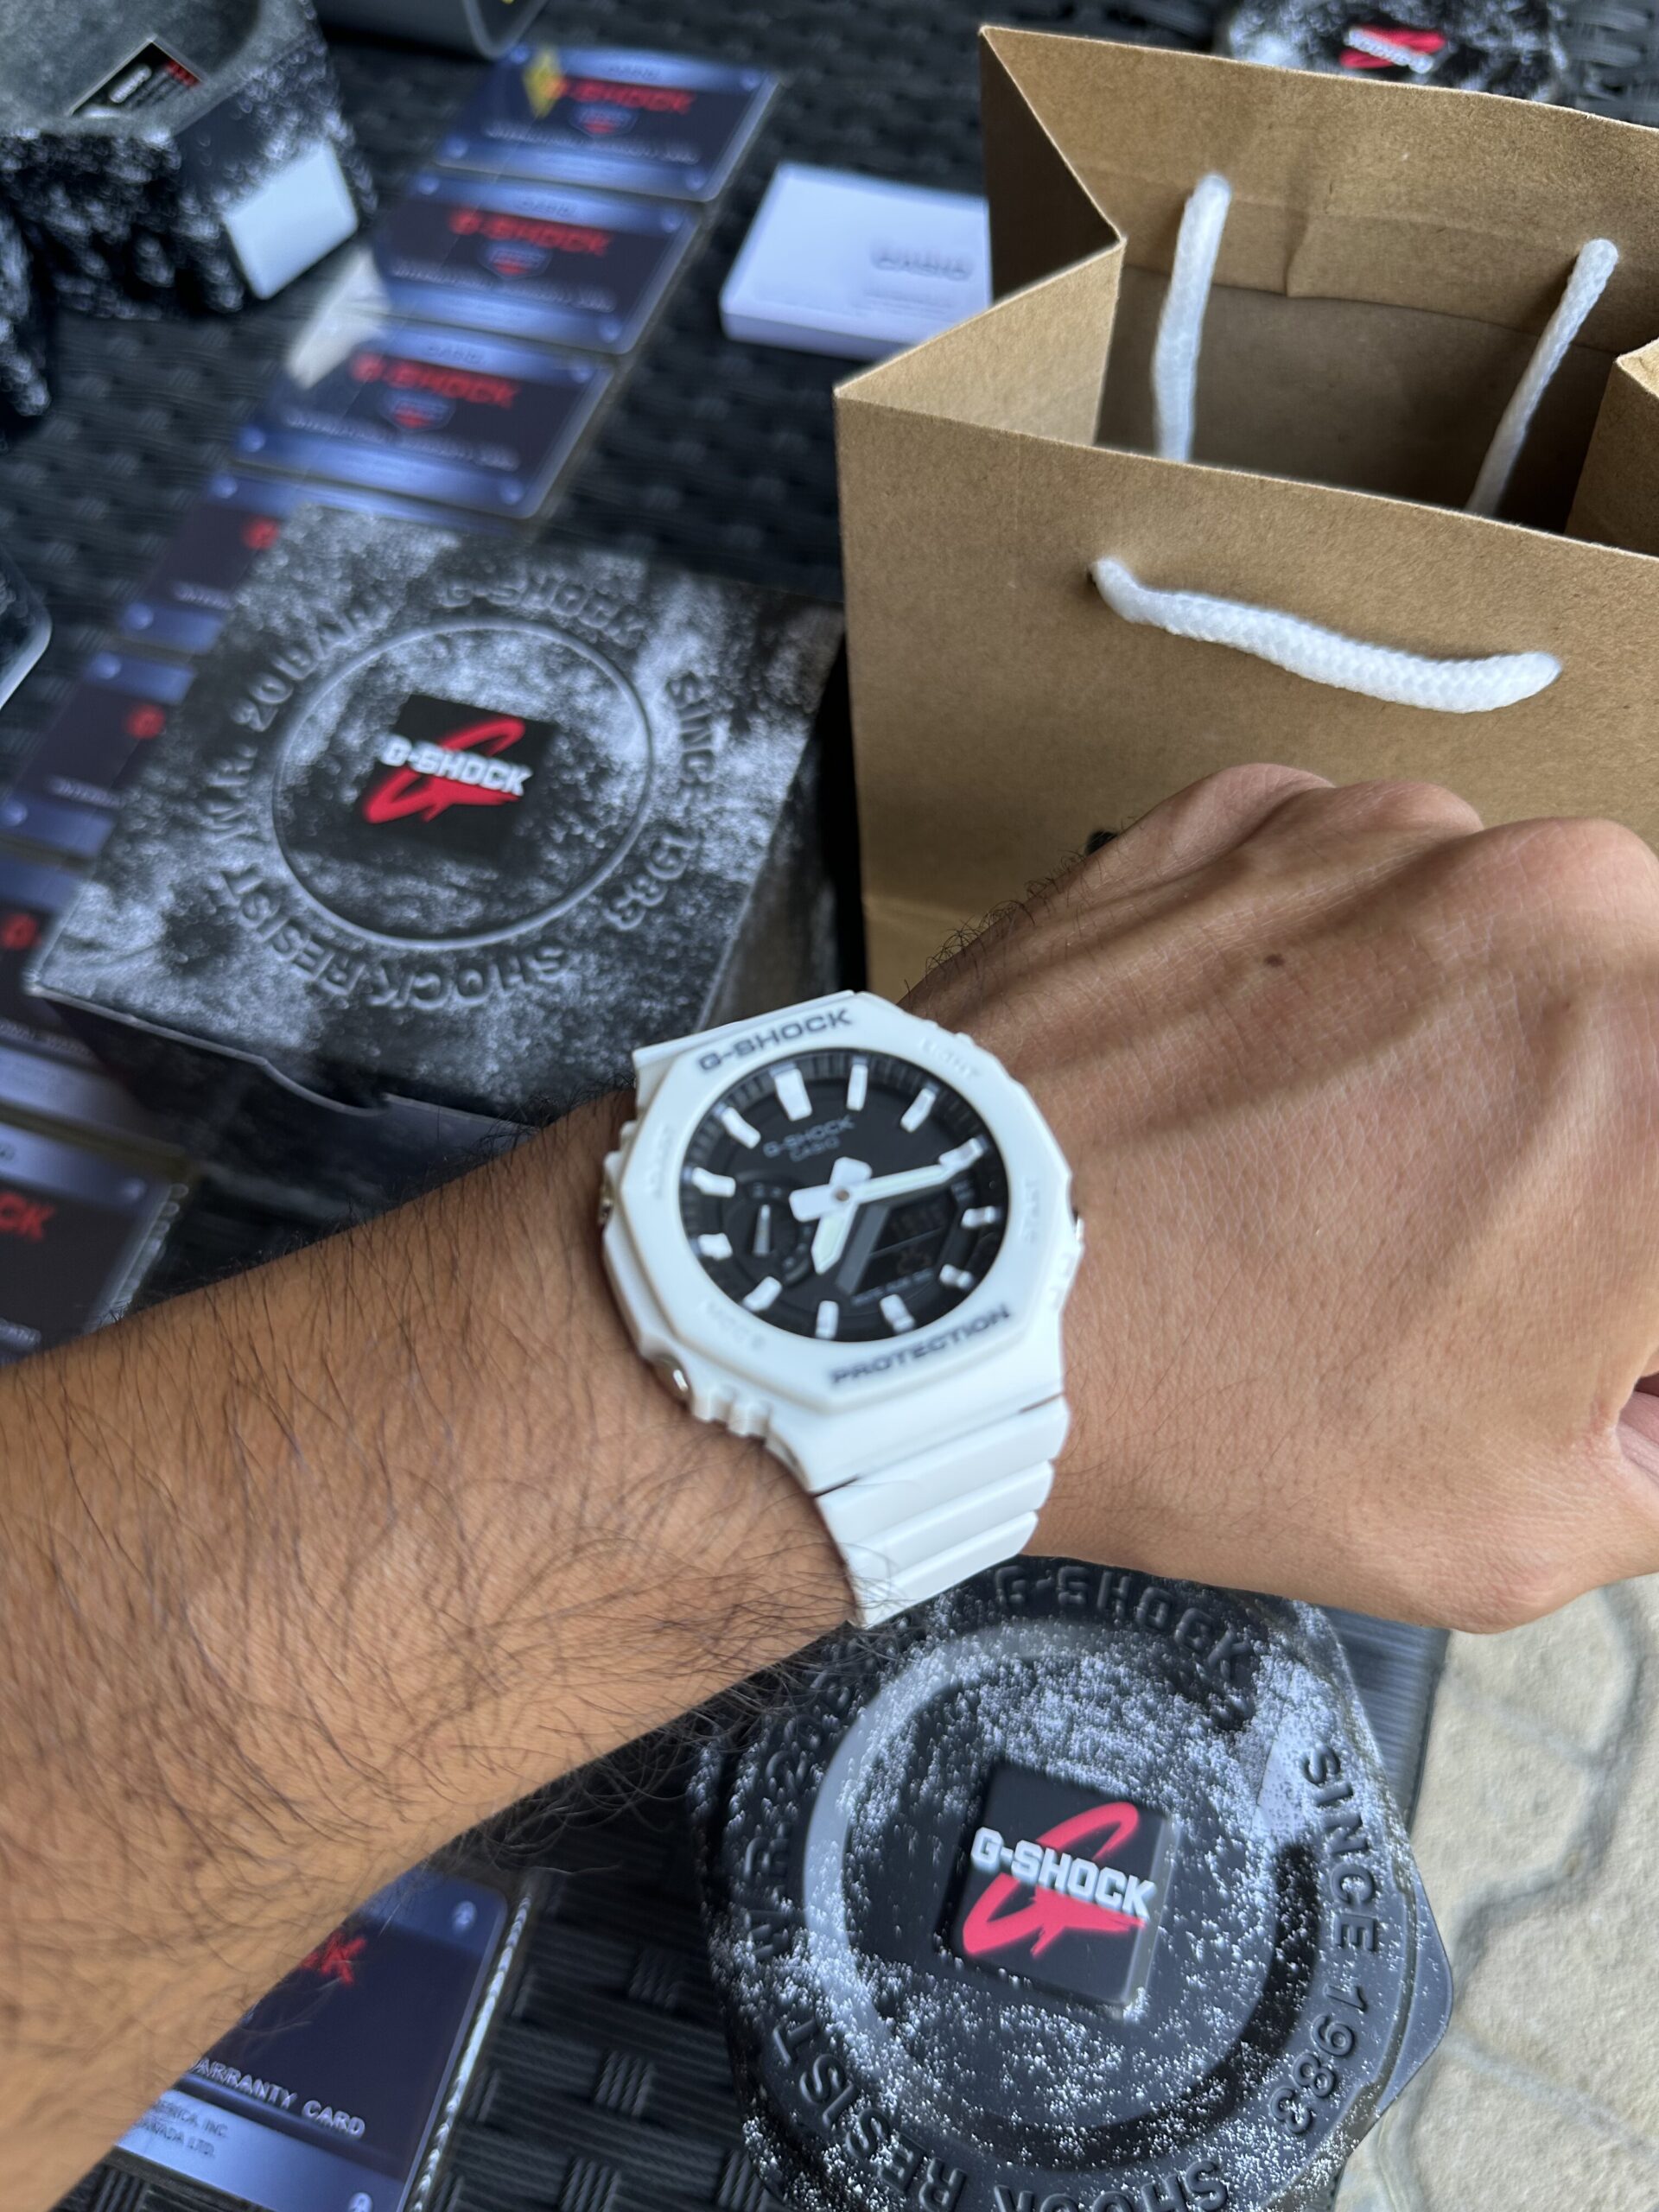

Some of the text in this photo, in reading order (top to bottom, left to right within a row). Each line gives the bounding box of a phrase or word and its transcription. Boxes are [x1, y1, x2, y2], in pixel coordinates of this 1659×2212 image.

[378, 733, 533, 797] G-SHOCK
[603, 830, 704, 931] 1983
[219, 867, 572, 1011] SHOCK RESIST
[698, 1007, 854, 1071] G-SHOCK
[762, 1114, 855, 1158] G-SHOCK
[830, 1303, 1011, 1384] PROTECTION
[995, 1565, 1255, 1681] G-SHOCK
[970, 1826, 1156, 1923] G-SHOCK
[1268, 1741, 1377, 2136] SINCE 1983
[191, 2056, 365, 2139] ARRANTY CARD
[772, 2018, 969, 2212] RESIST
